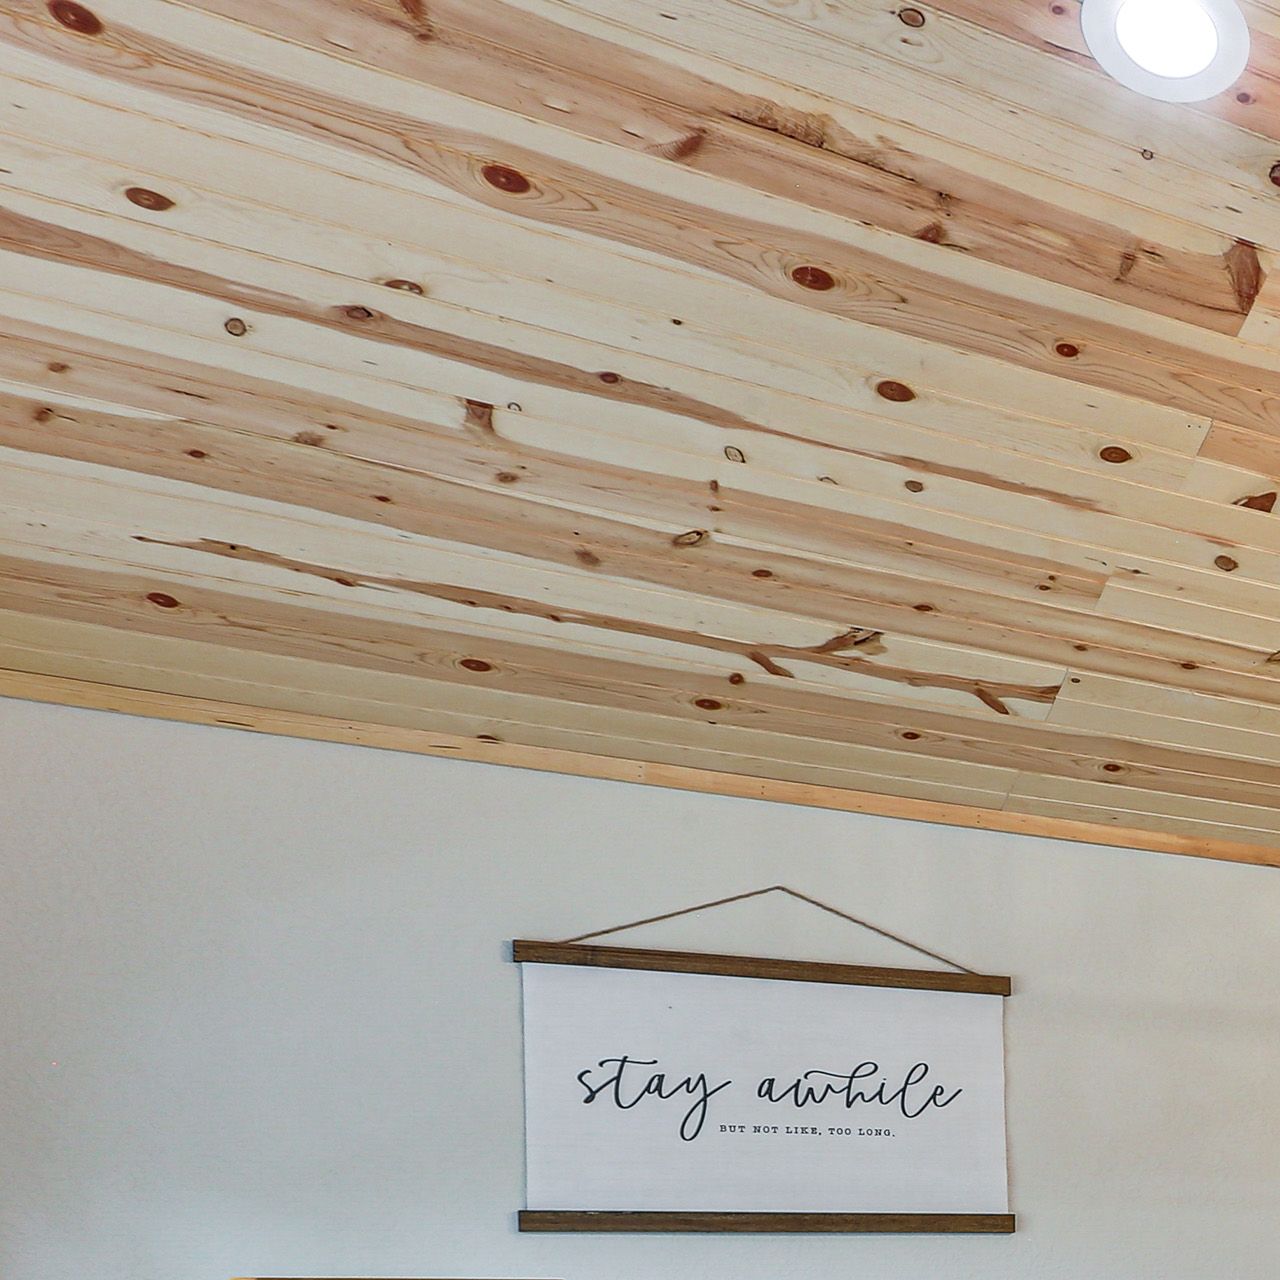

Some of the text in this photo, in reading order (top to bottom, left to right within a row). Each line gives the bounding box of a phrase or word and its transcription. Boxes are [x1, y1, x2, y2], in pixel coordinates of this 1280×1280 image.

[577, 1056, 963, 1141] stay awhile
[719, 1124, 896, 1138] BUT NOT LIKE, TOO LONG.
